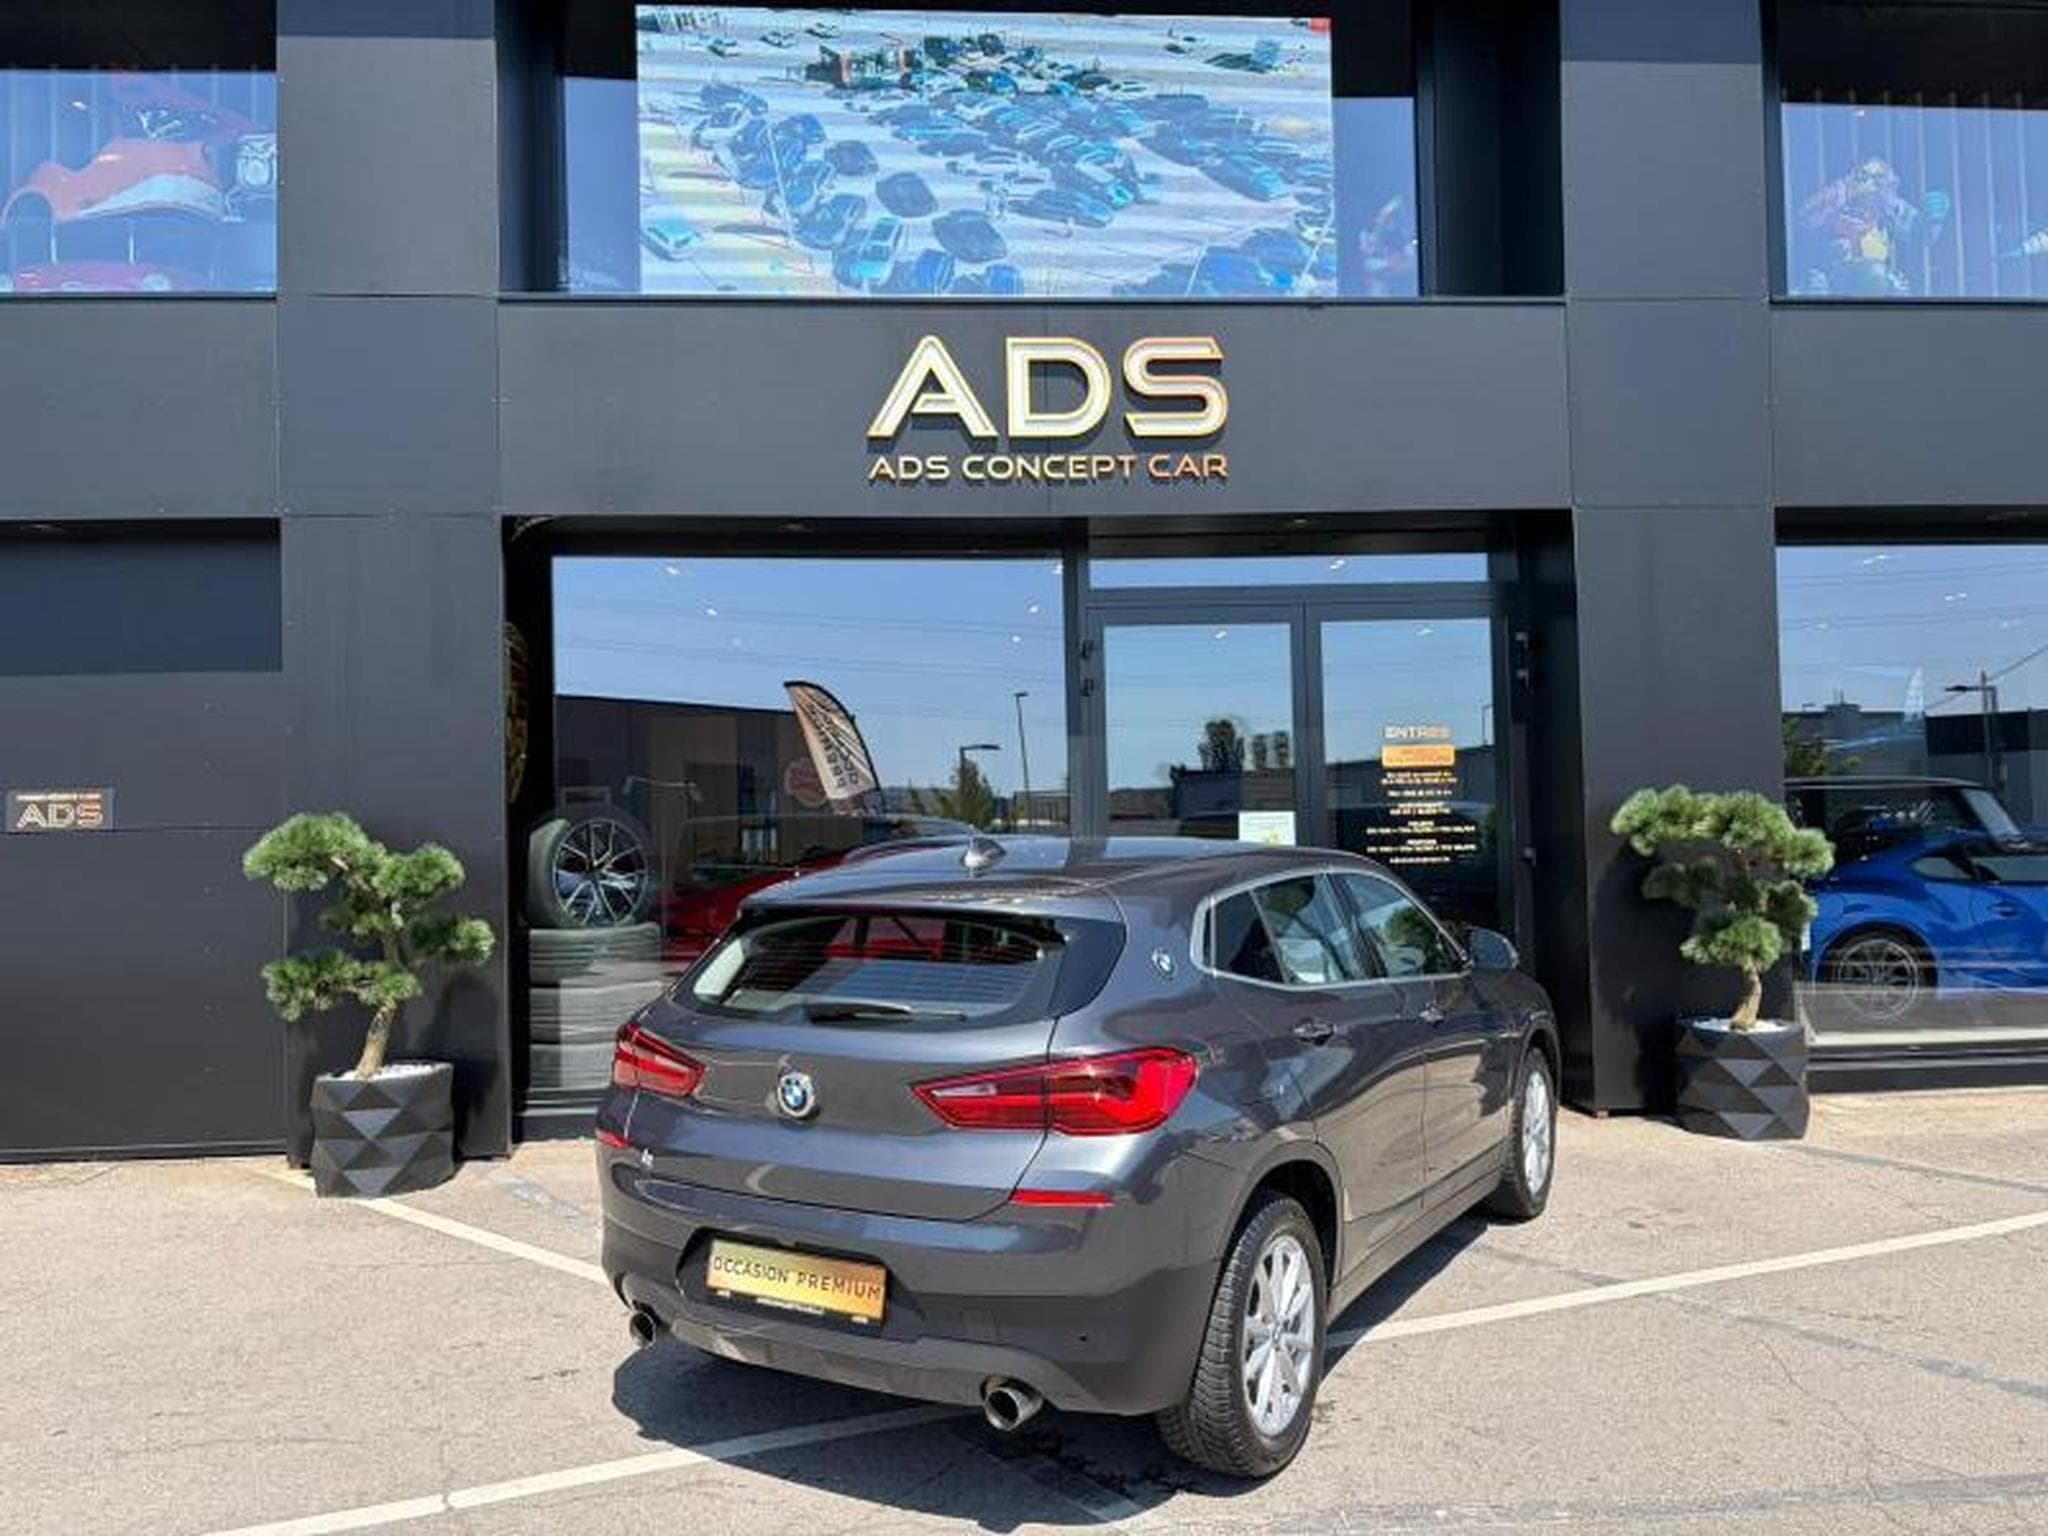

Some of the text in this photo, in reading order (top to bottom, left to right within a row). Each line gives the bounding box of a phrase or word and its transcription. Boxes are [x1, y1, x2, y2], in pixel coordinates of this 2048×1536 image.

[867, 334, 1229, 437] ADS
[868, 453, 1229, 481] ADS CONCEPT CAR
[16, 802, 103, 830] ADS
[713, 1255, 882, 1300] OCCASION PREMIUM
